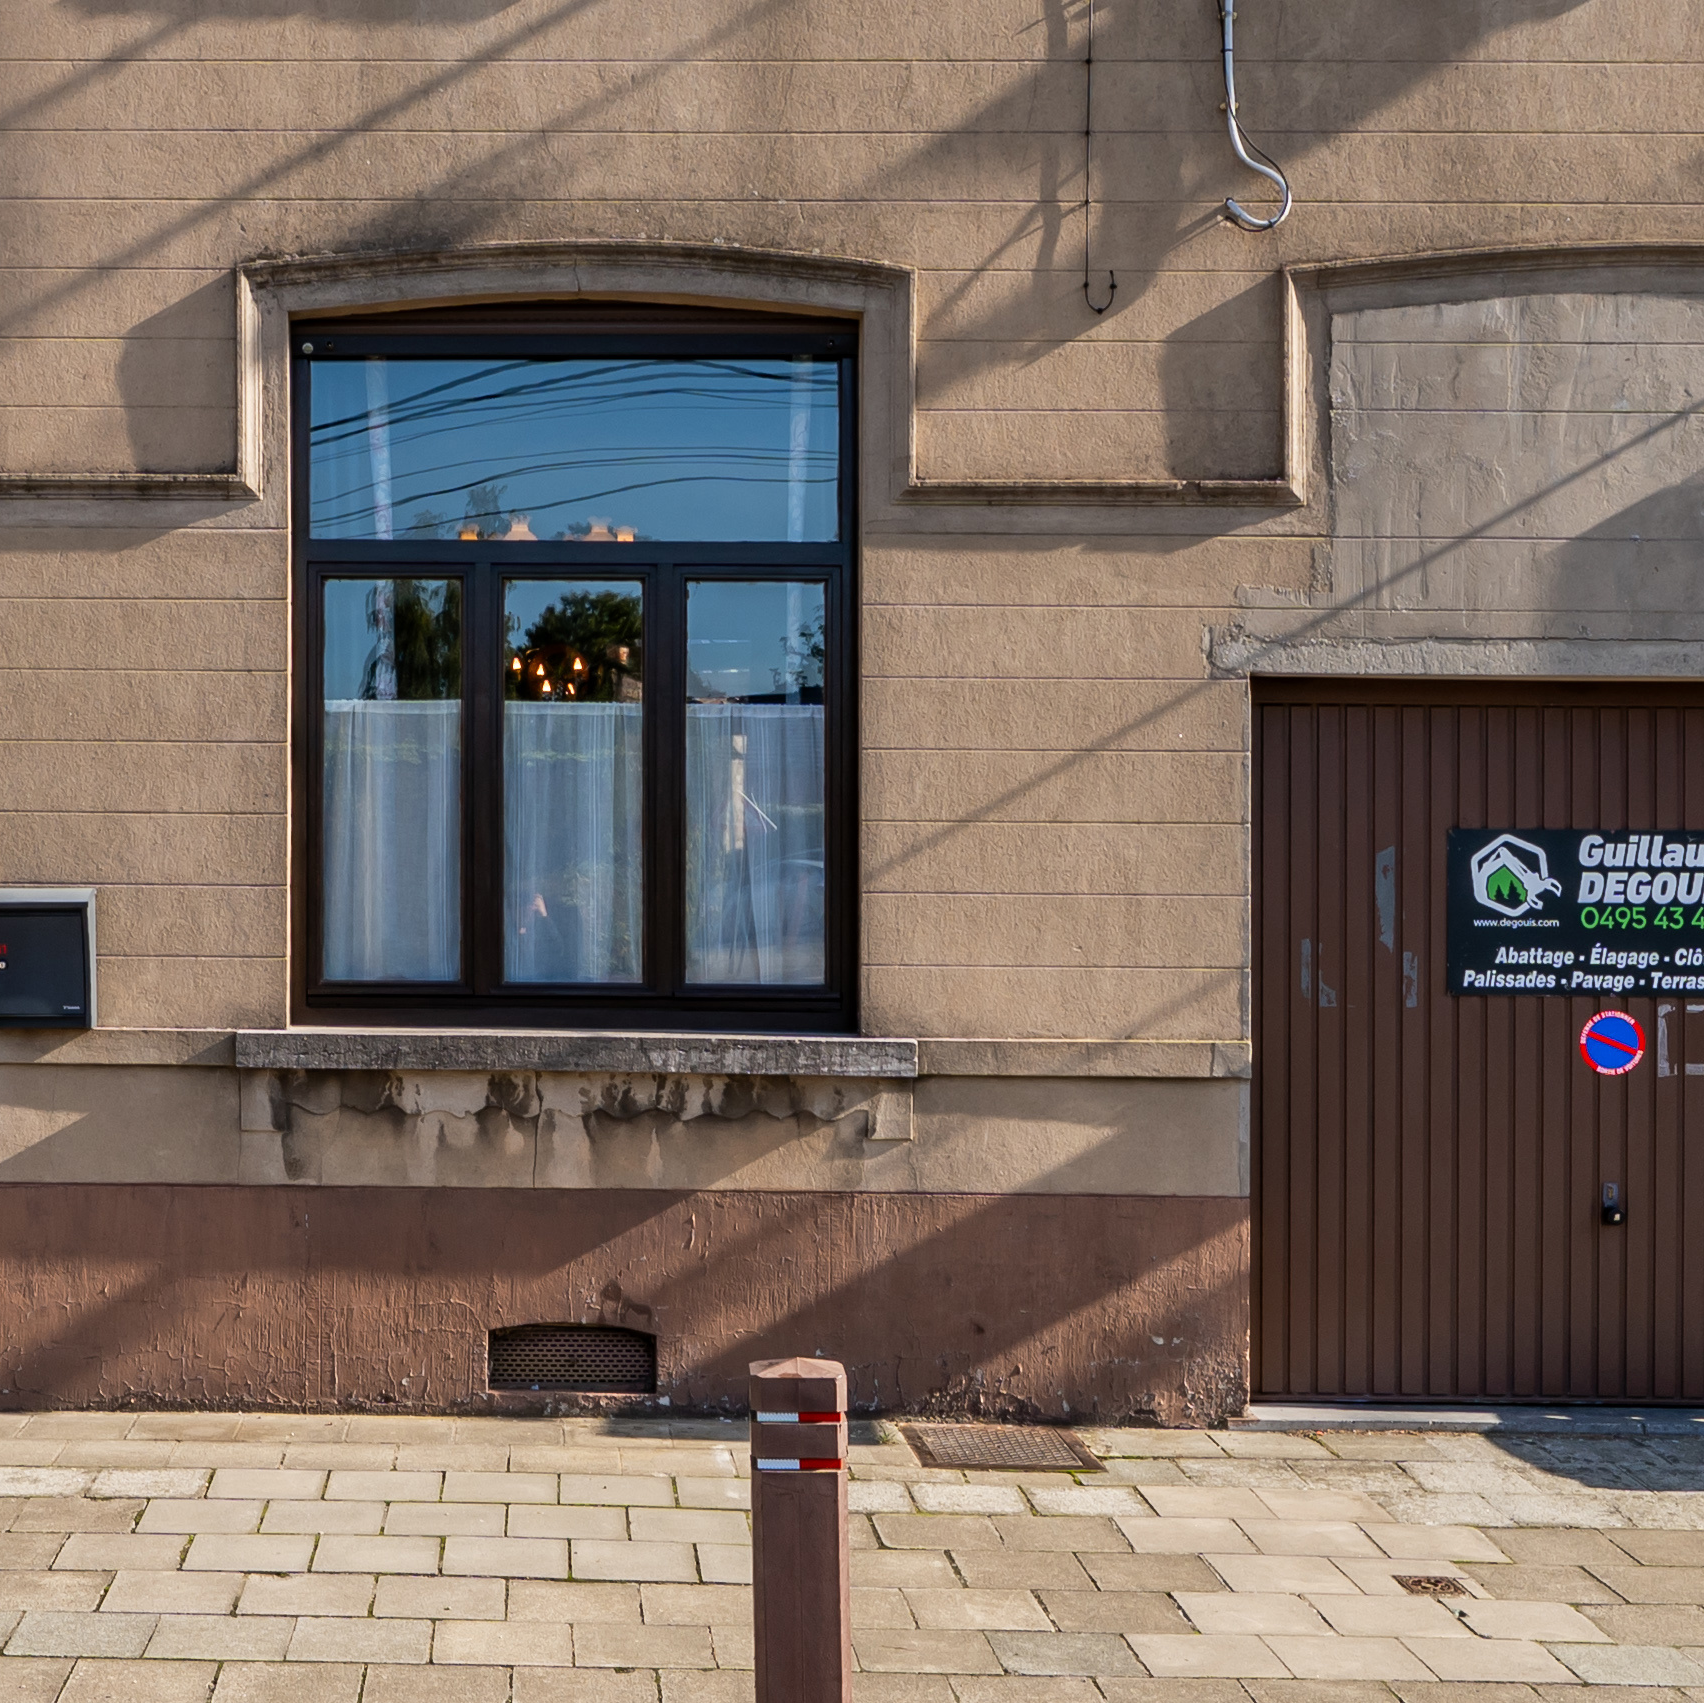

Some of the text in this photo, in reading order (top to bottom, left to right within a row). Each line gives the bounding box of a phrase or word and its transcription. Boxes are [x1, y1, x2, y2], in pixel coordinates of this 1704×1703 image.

[1473, 918, 1560, 929] www.degouis.com
[1580, 906, 1647, 930] 0495
[1653, 906, 1684, 930] 43
[1494, 946, 1575, 968] Abattage
[1589, 943, 1660, 969] Élagage
[1463, 969, 1557, 988] Palissades
[1571, 971, 1635, 991] Pavage
